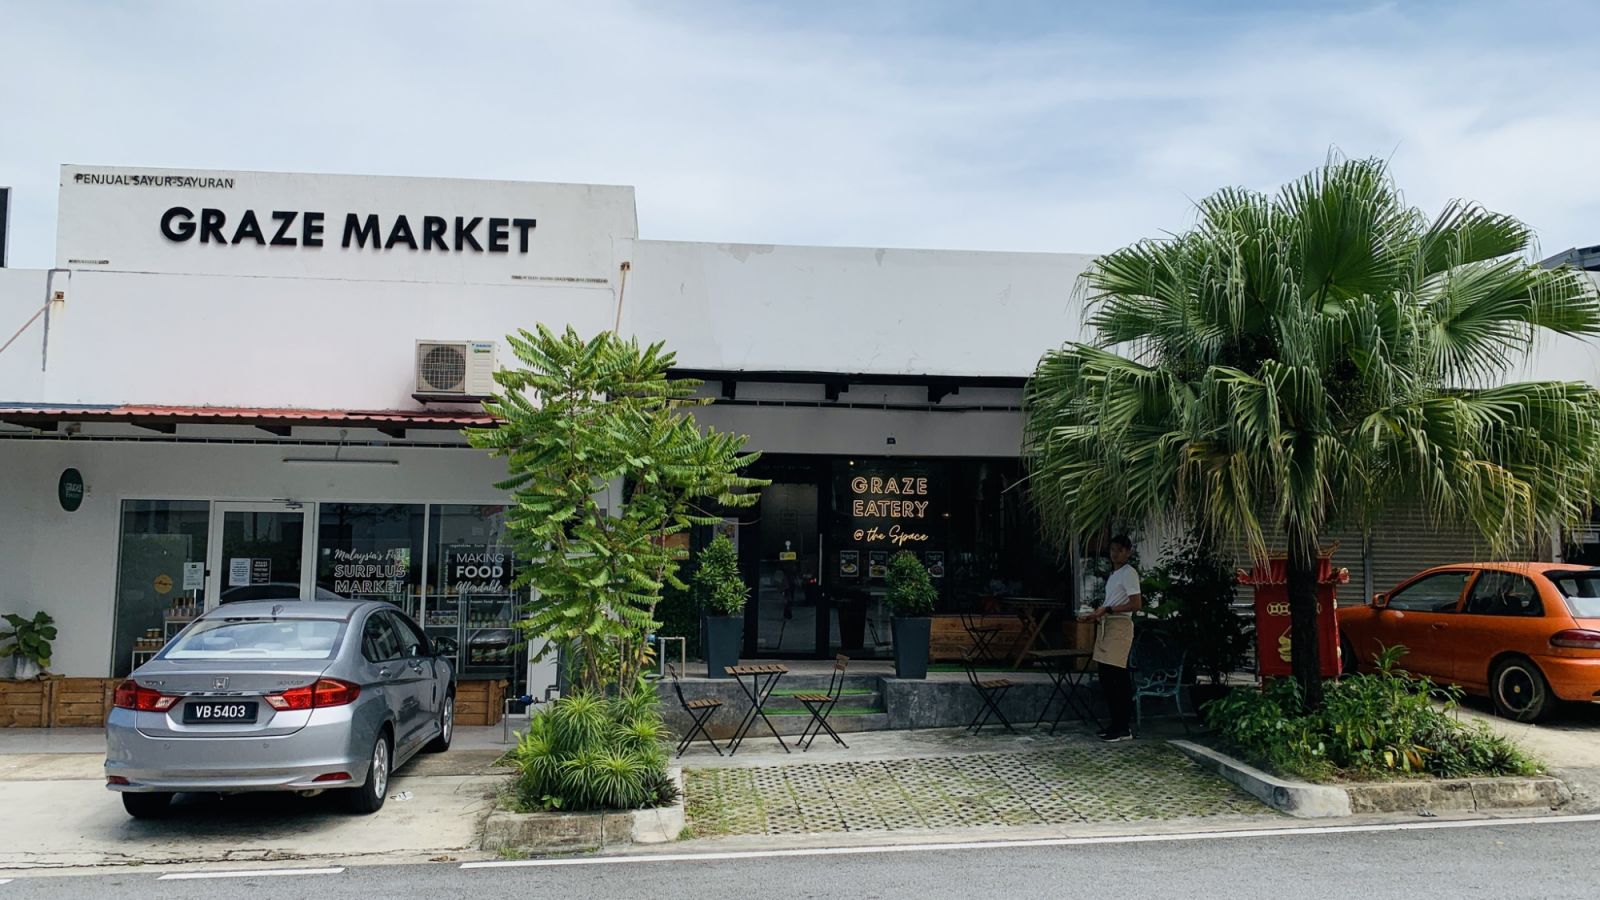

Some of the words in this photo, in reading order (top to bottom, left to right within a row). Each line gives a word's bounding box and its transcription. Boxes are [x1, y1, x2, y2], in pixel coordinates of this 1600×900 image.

[75, 173, 130, 186] PENJUAL
[133, 175, 234, 189] SAYUR-SAYURAN
[160, 206, 325, 248] GRAZE
[342, 213, 537, 254] MARKET
[851, 476, 928, 495] GRAZE
[852, 499, 929, 518] EATERY
[853, 529, 864, 541] @
[866, 526, 886, 542] the
[888, 524, 929, 547] Space
[334, 548, 384, 564] Malaysia's
[456, 553, 505, 563] MAKING
[333, 564, 406, 578] SURPLUS
[456, 565, 504, 578] FOOD
[334, 580, 405, 593] MARKET
[195, 705, 212, 718] VB
[213, 705, 246, 718] 5403
